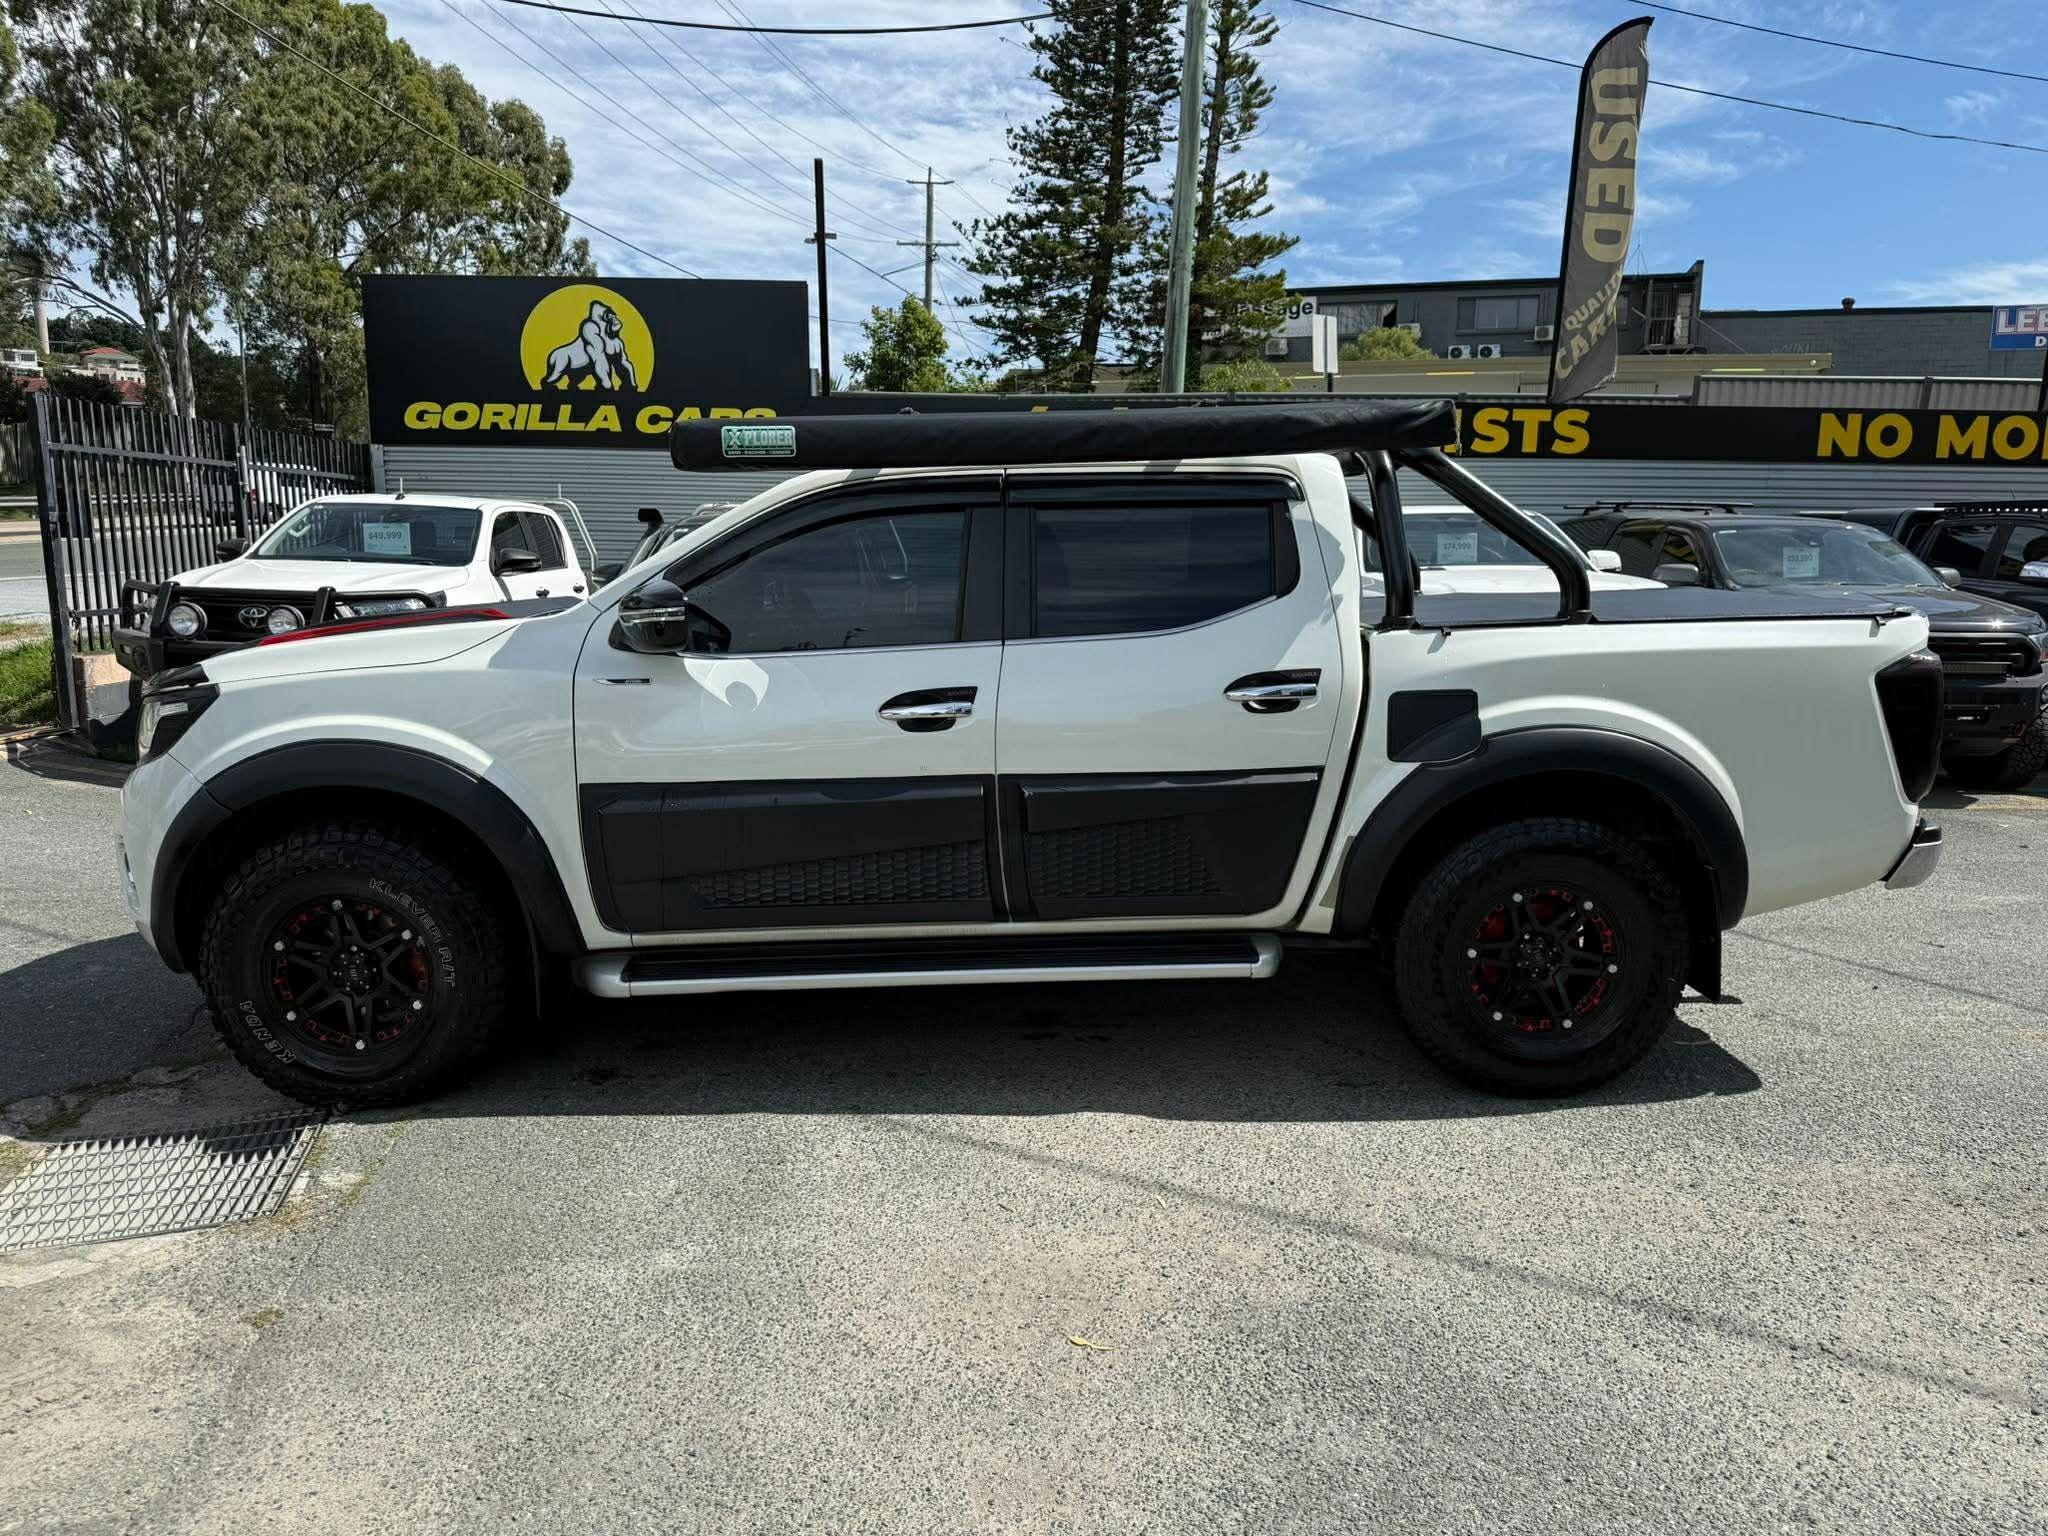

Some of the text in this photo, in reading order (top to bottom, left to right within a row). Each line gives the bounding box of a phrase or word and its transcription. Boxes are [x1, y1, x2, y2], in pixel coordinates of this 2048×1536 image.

[1583, 67, 1638, 262] USED
[404, 402, 622, 433] GORILLA
[727, 430, 793, 447] XPLORER
[1817, 413, 2048, 461] NO MO
[240, 1000, 297, 1064] KENDA
